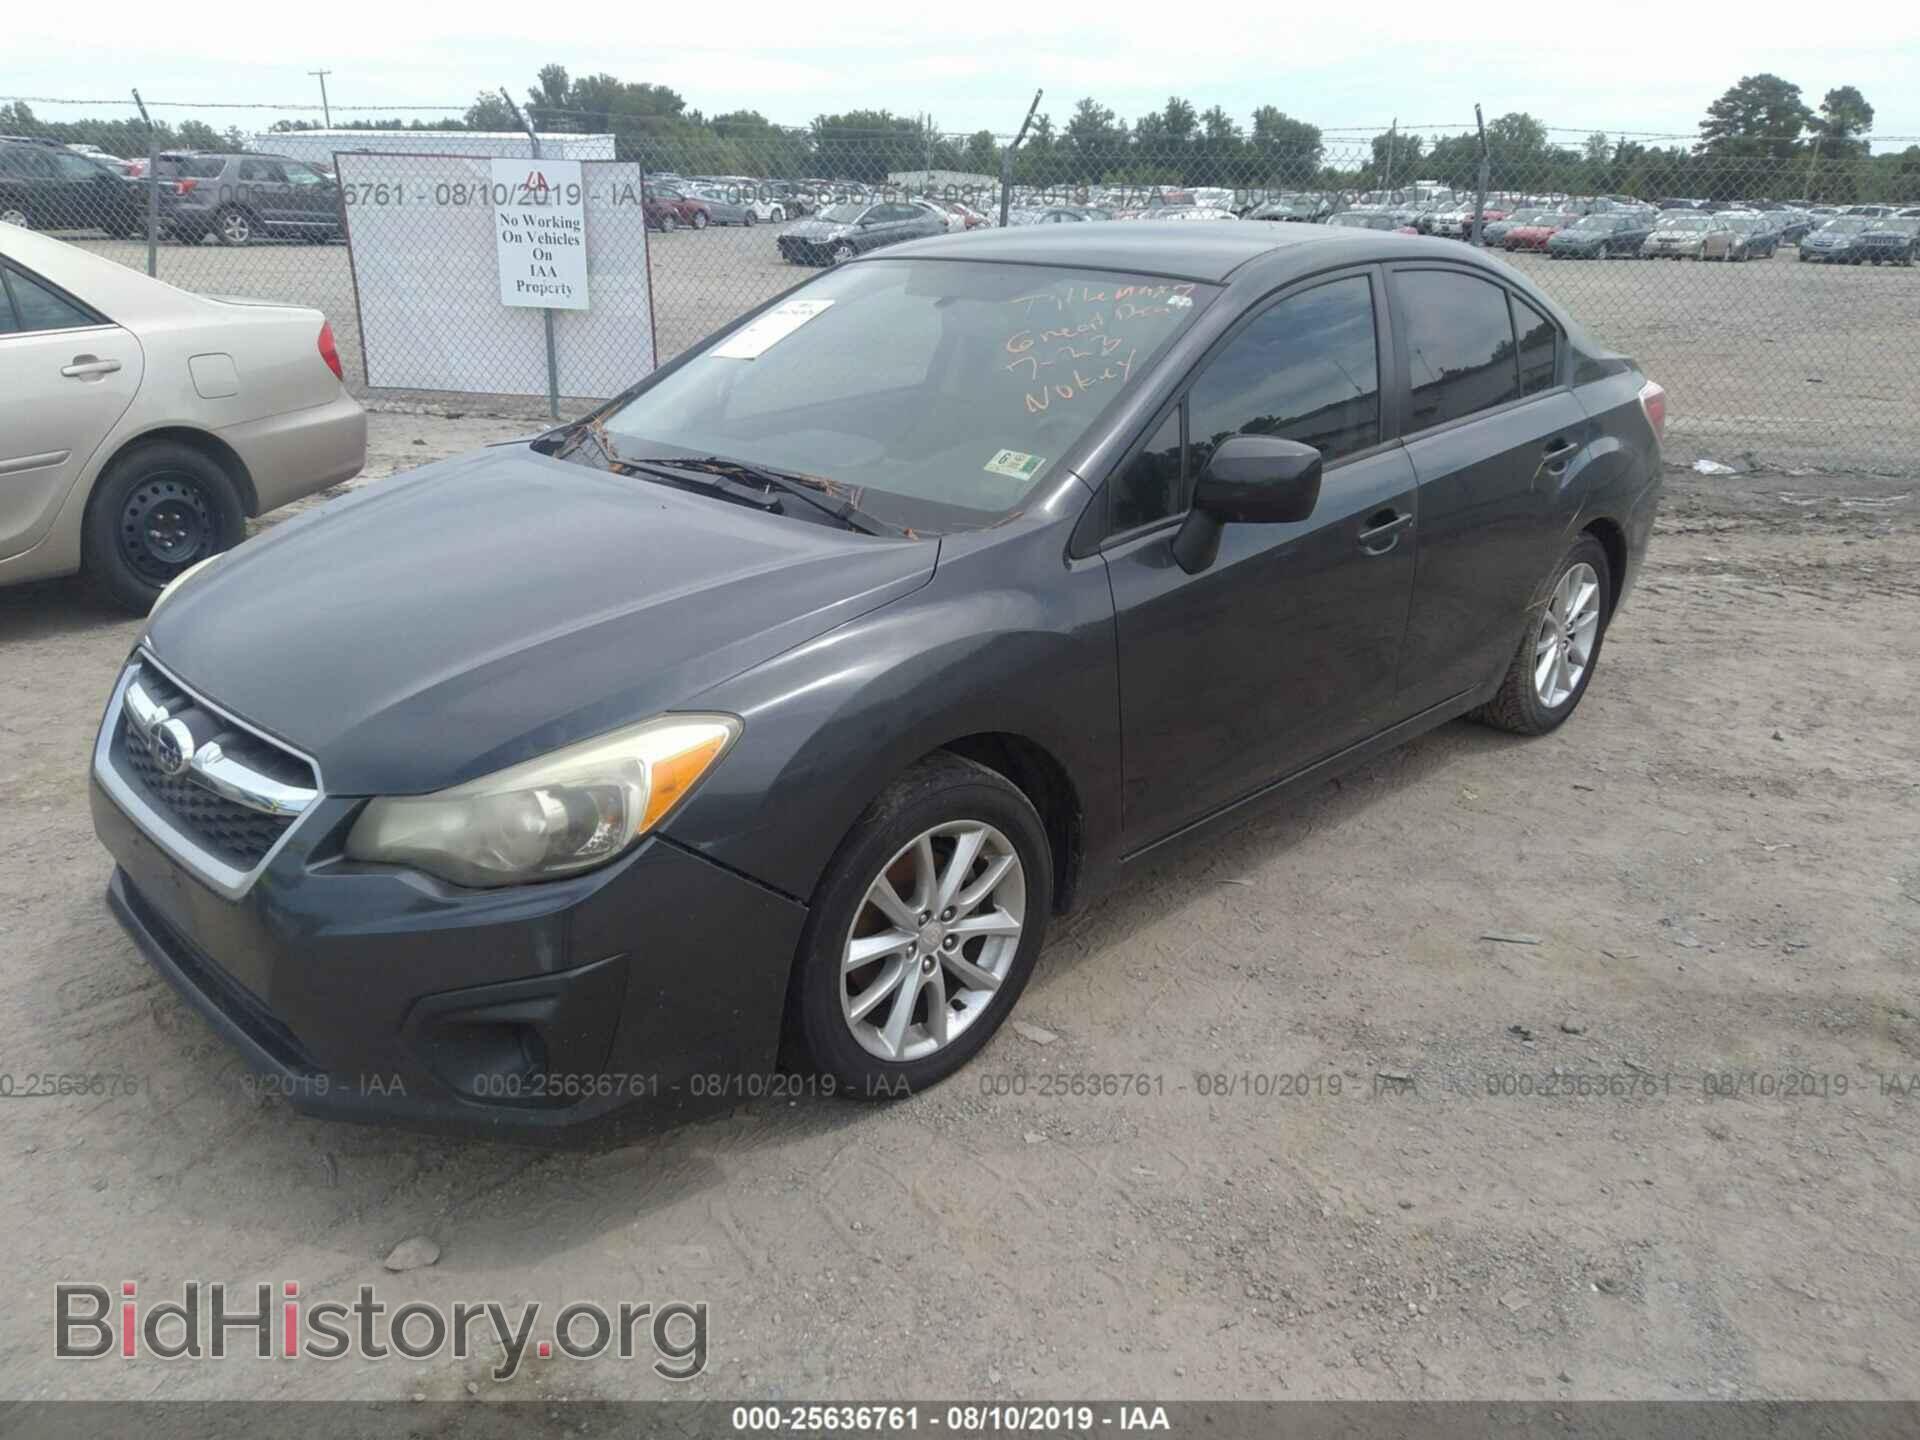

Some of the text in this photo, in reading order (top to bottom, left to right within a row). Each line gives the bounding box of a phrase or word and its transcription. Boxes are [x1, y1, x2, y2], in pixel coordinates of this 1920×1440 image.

[500, 213, 581, 232] No Working
[502, 230, 580, 246] On Vehicles
[532, 247, 553, 261] On
[530, 264, 557, 278] IAA
[516, 279, 572, 298] Property
